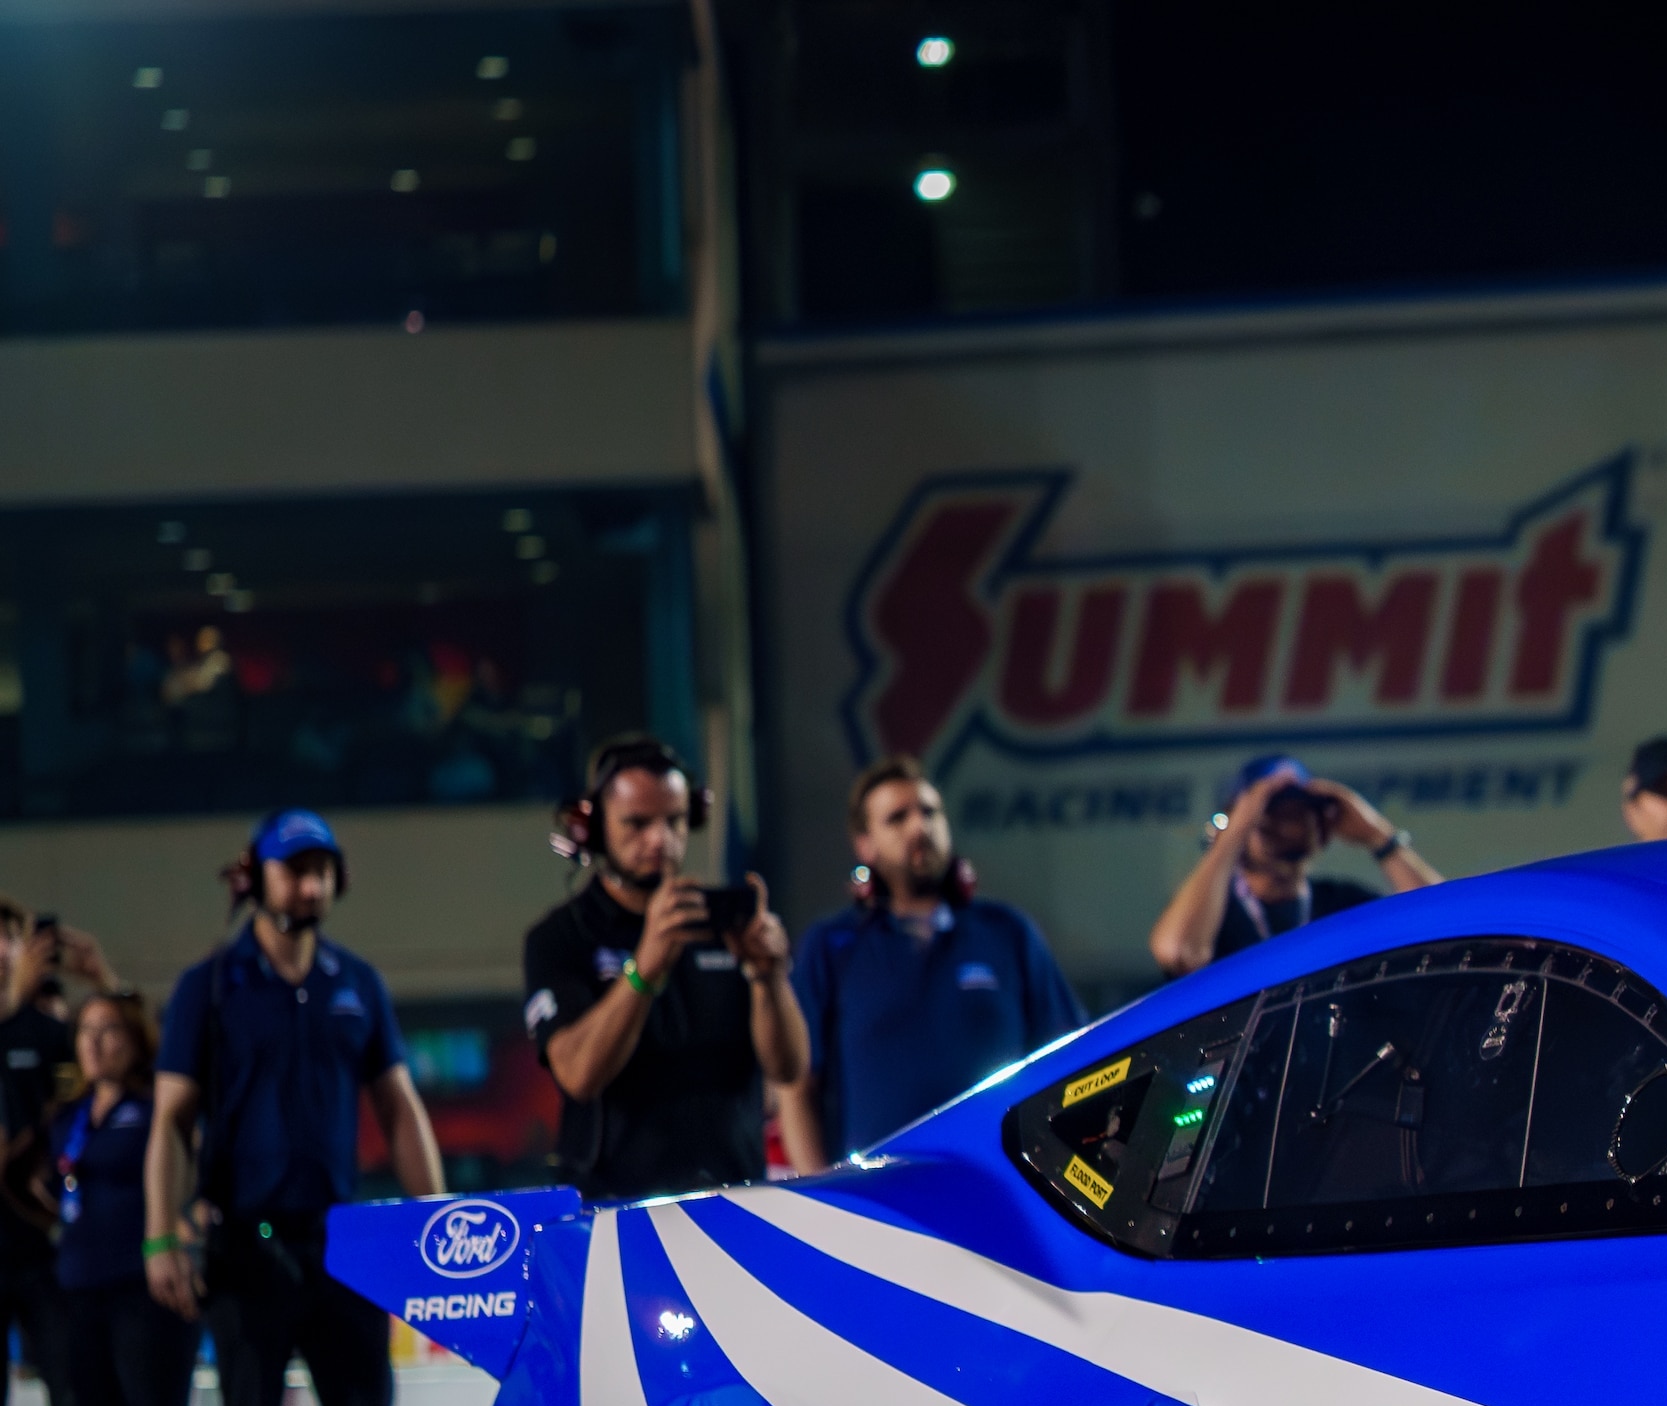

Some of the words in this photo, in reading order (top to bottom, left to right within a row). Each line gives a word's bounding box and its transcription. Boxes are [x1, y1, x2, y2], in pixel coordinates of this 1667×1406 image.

[1070, 1163, 1091, 1188] FLOOD
[1089, 1180, 1108, 1201] PORT
[436, 1210, 501, 1266] Ford
[404, 1291, 517, 1322] RACING
